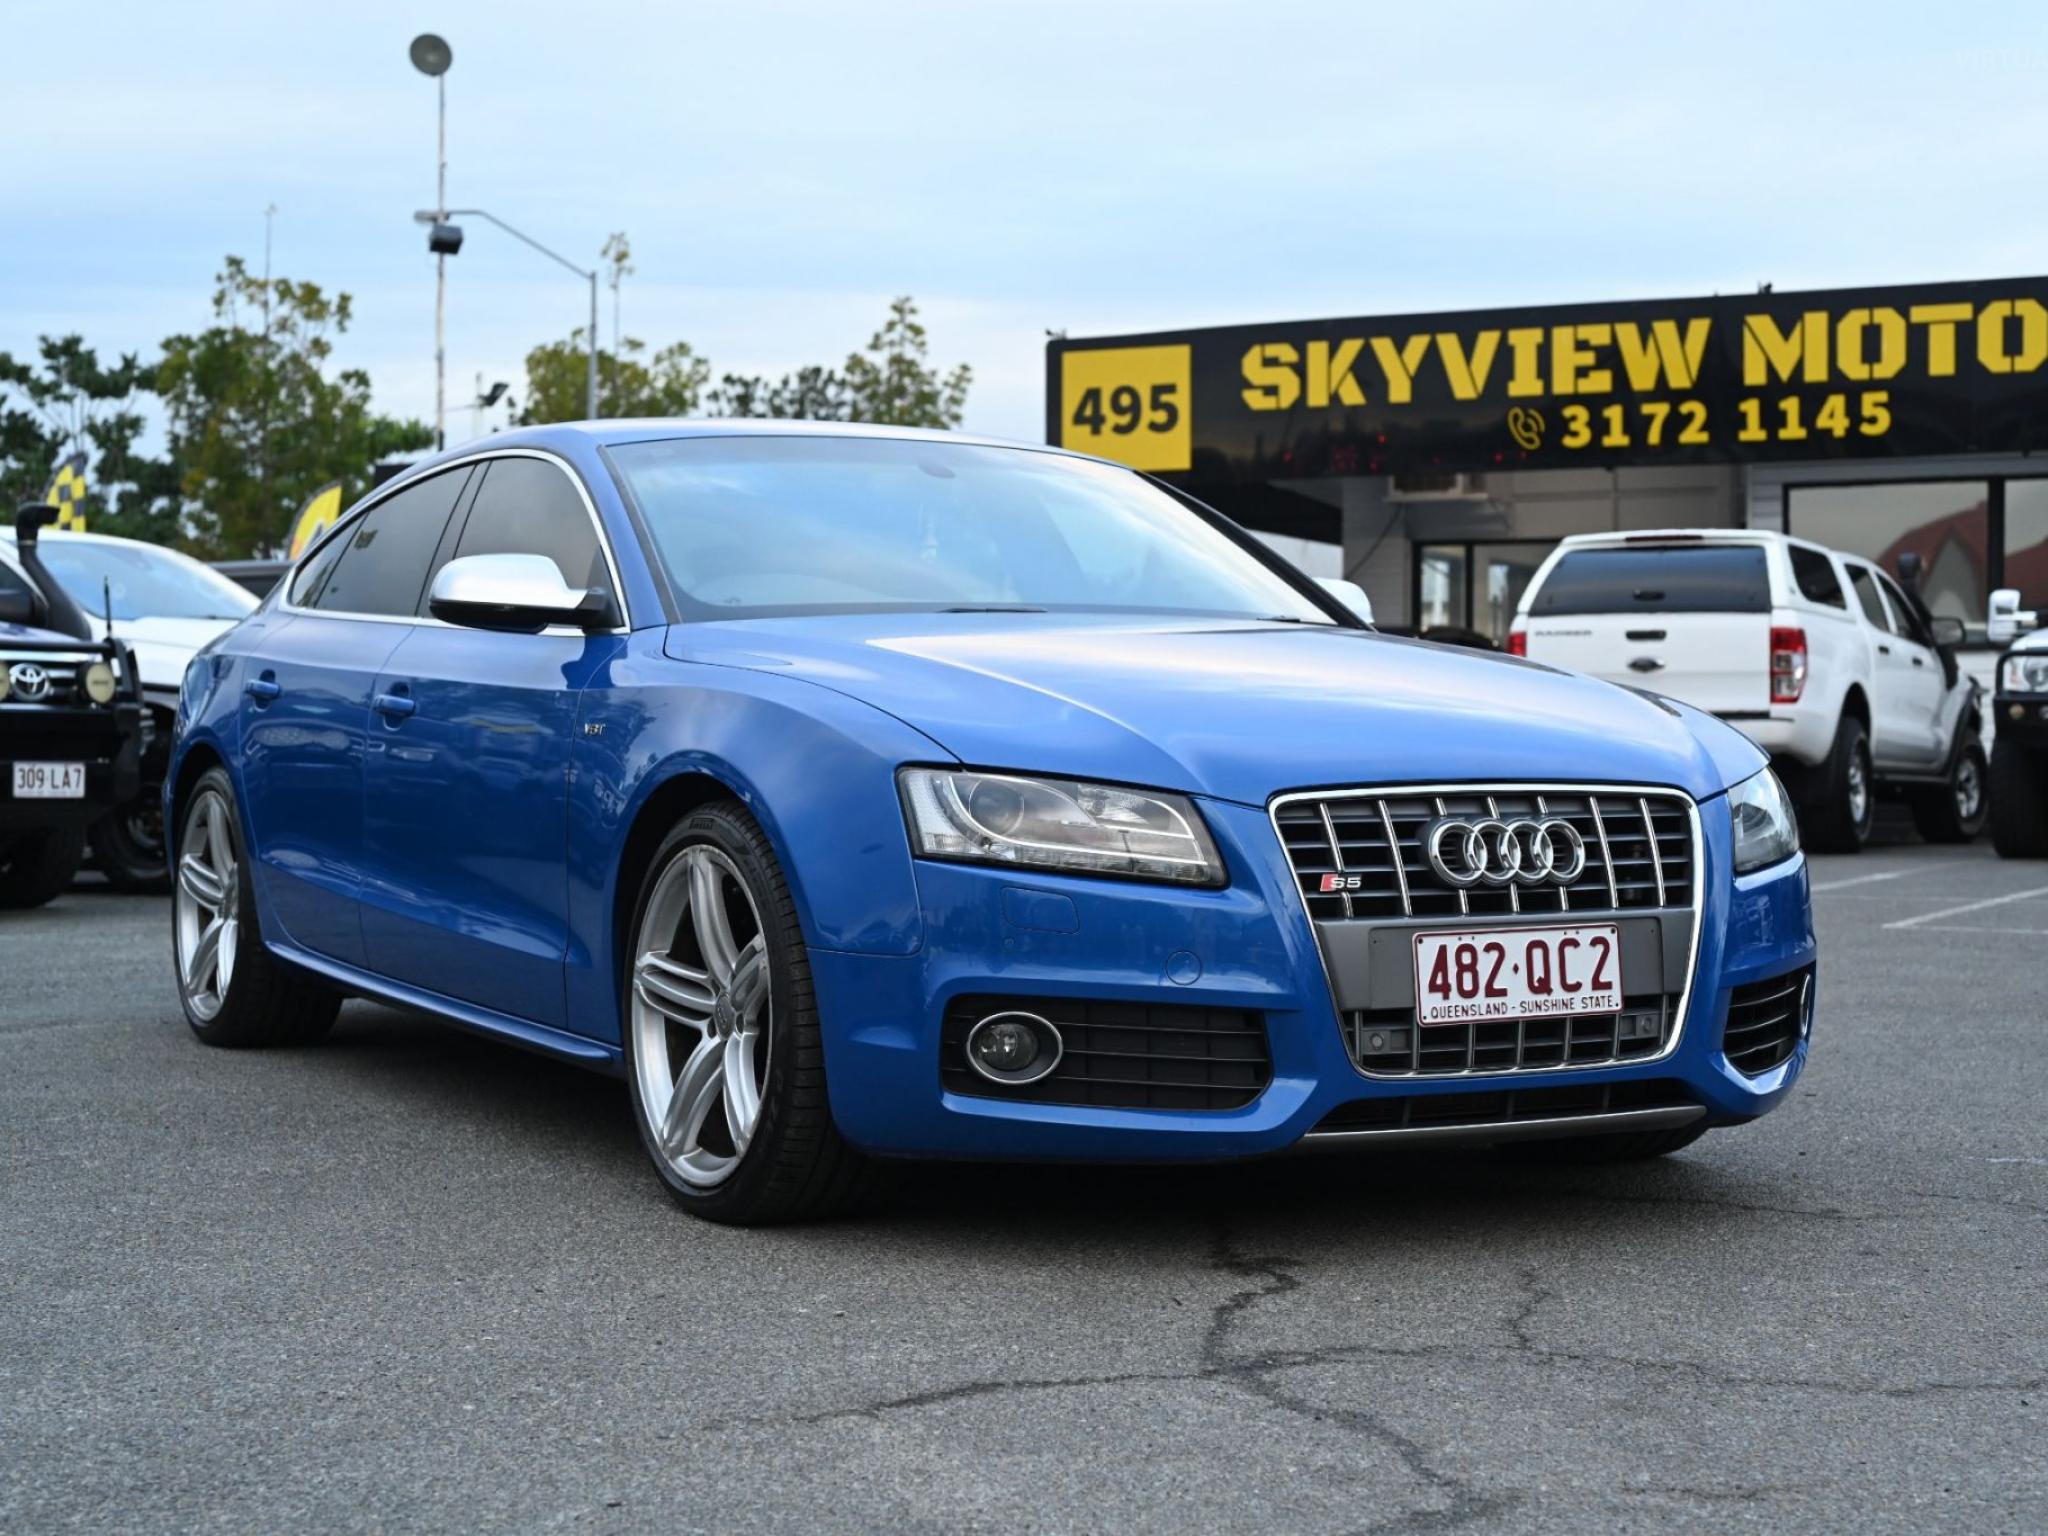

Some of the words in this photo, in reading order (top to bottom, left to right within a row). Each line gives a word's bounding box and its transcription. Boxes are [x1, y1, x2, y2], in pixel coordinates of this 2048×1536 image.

[1241, 318, 1712, 412] SKYVIEW
[1742, 298, 2048, 387] MOTO
[1071, 383, 1180, 437] 495
[1560, 399, 1711, 449] 3172
[1737, 390, 1893, 442] 1145
[1330, 876, 1362, 889] S5
[1430, 1001, 1508, 1020] QUEENSLAND
[1519, 997, 1575, 1014] SUNSHINE
[1581, 994, 1614, 1010] STATE
